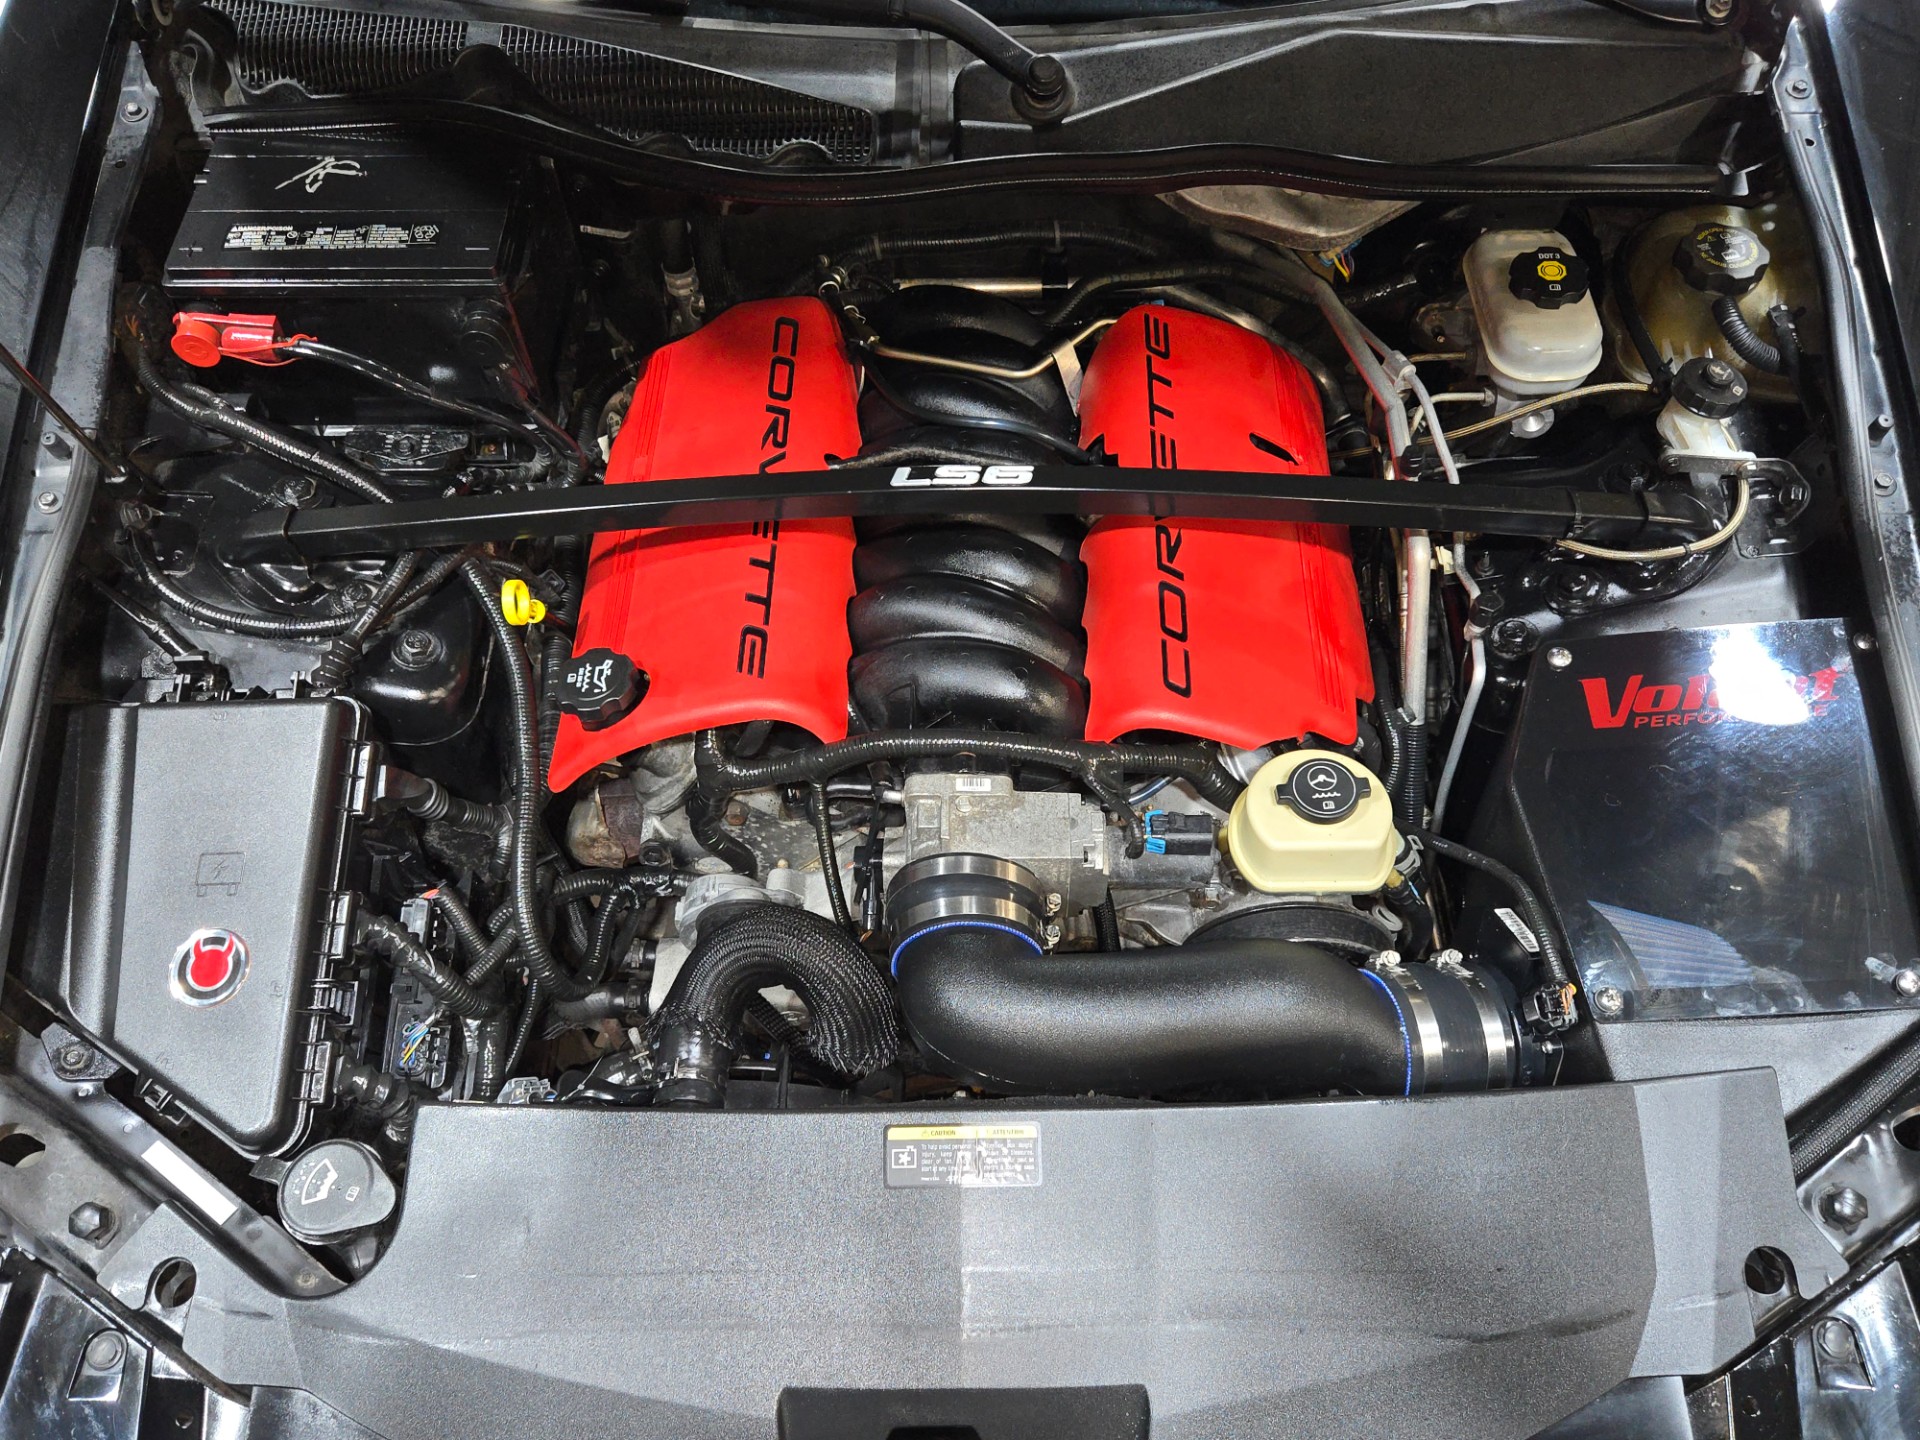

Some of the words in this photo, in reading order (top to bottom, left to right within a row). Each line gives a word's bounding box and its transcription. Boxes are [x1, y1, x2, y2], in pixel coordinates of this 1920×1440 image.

[890, 464, 1035, 487] LS6
[1144, 312, 1192, 699] CORETTE
[1578, 666, 1844, 729] Volt
